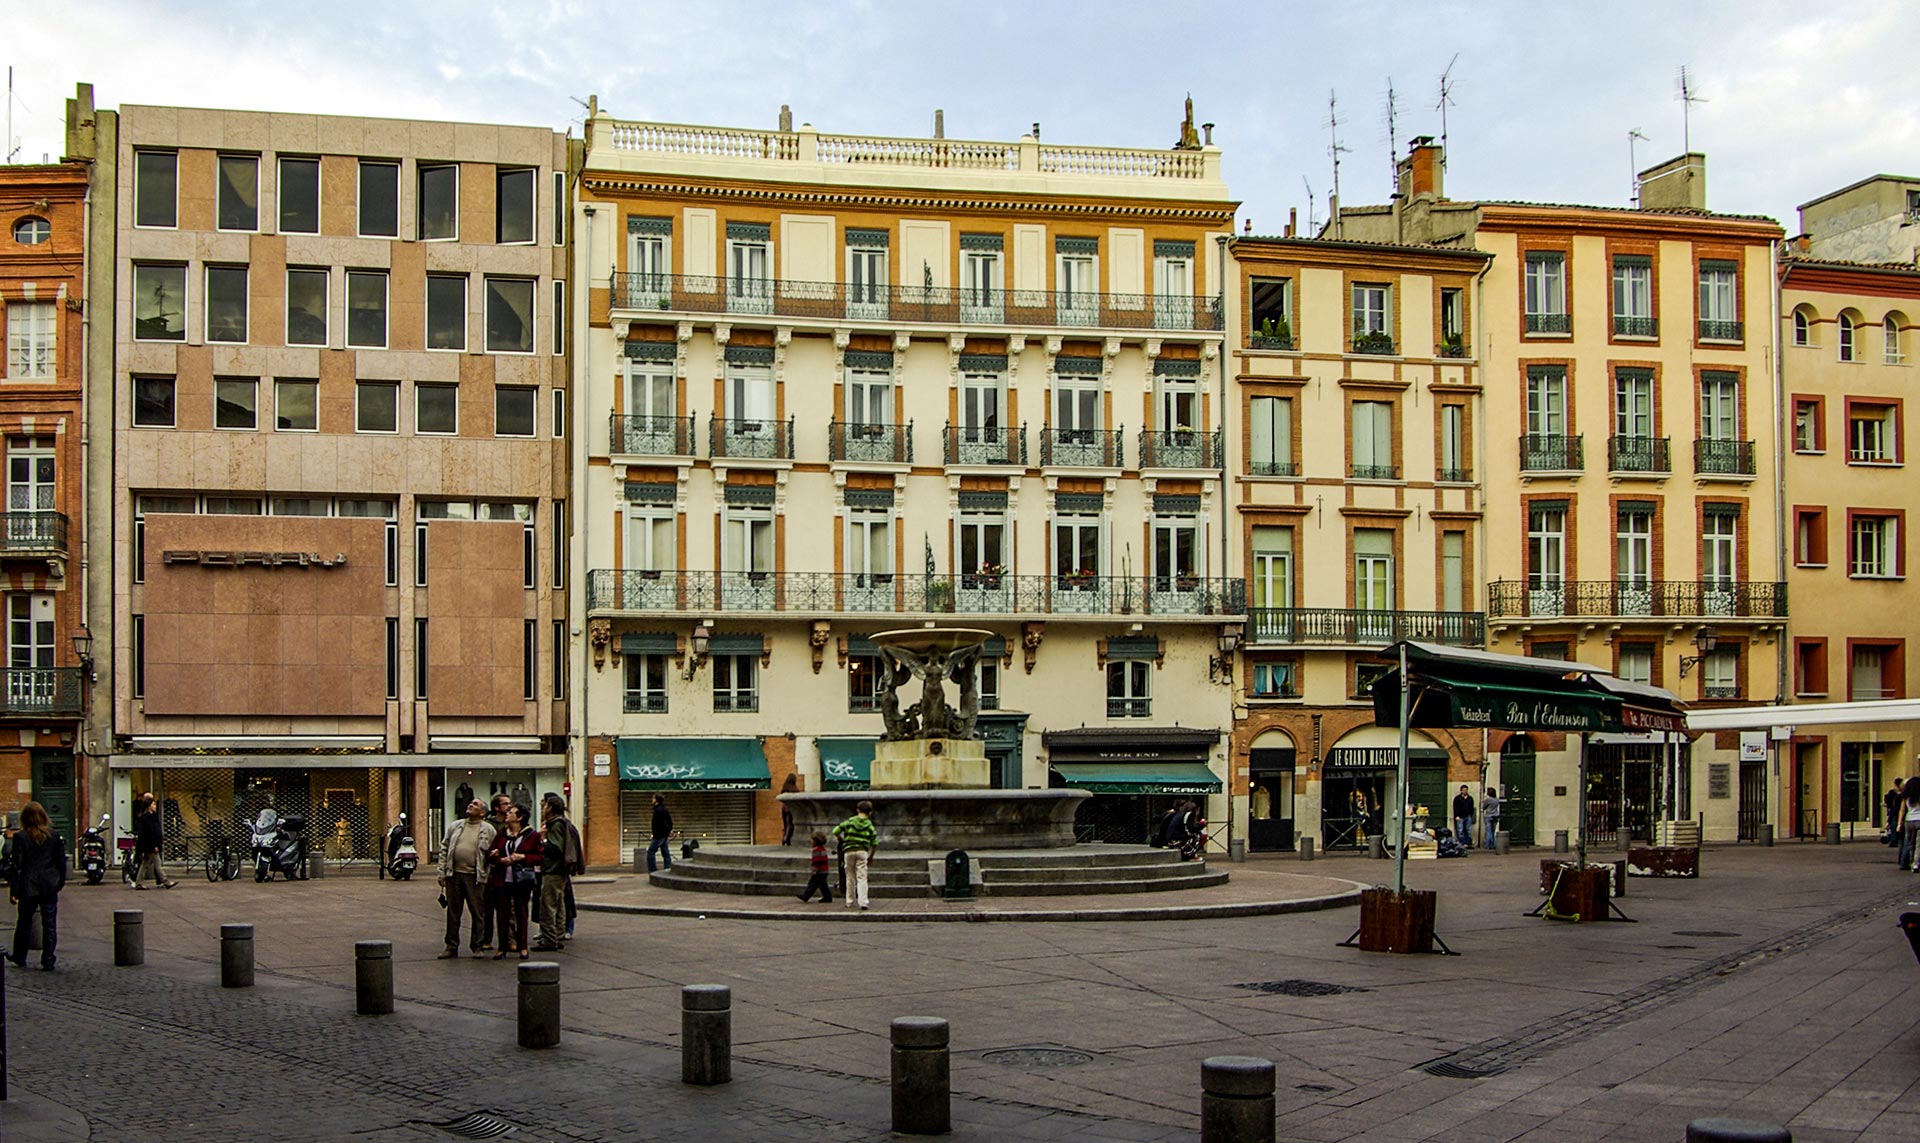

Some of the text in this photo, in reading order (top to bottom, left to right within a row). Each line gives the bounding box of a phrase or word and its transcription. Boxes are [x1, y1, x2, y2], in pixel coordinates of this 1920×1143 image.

[1505, 701, 1529, 724] Bar
[1335, 749, 1399, 766] LE GRAND MAGASIN
